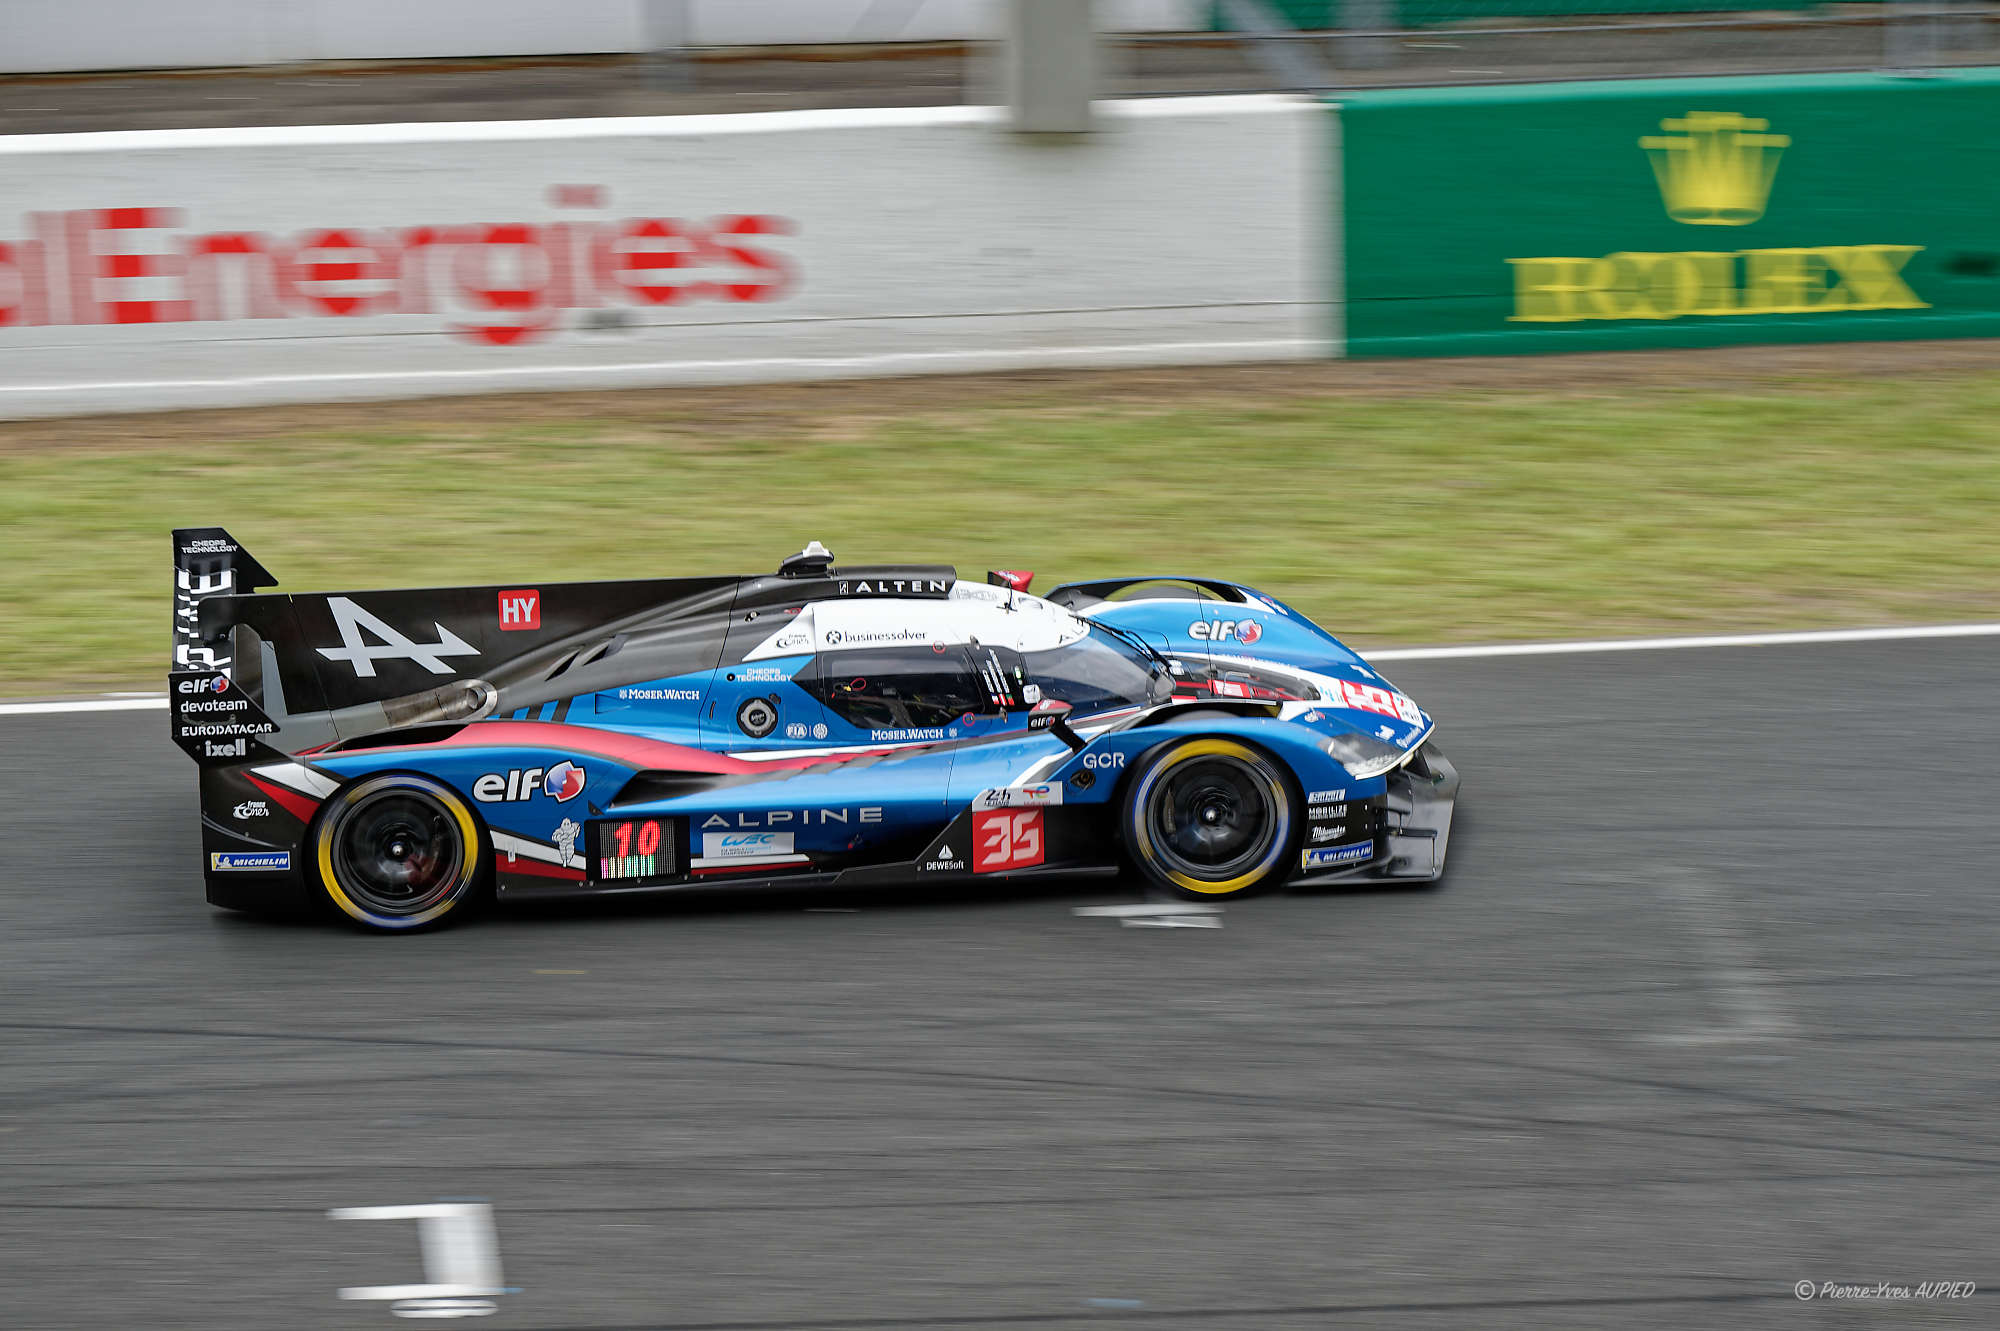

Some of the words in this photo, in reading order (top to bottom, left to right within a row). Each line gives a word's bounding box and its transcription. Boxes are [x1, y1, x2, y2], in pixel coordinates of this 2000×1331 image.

[0, 184, 800, 345] lEnergies
[1504, 245, 1931, 321] ROLEX
[182, 545, 238, 554] TECHNOLOGY
[856, 580, 946, 593] ALTEN
[502, 598, 536, 624] HY
[845, 629, 928, 643] businessolver
[1188, 619, 1236, 641] elf
[178, 679, 211, 693] elf
[736, 674, 792, 682] TECHNOLOGY
[180, 699, 248, 713] devoteam
[181, 722, 272, 737] EURODATACAR
[205, 738, 246, 757] ixell
[1083, 752, 1125, 769] GCR
[473, 768, 542, 802] elf
[701, 807, 882, 828] ALPINE
[614, 820, 661, 858] 10
[981, 810, 1039, 865] 35
[233, 857, 288, 867] MICHELIN
[926, 860, 964, 871] DEWESoft
